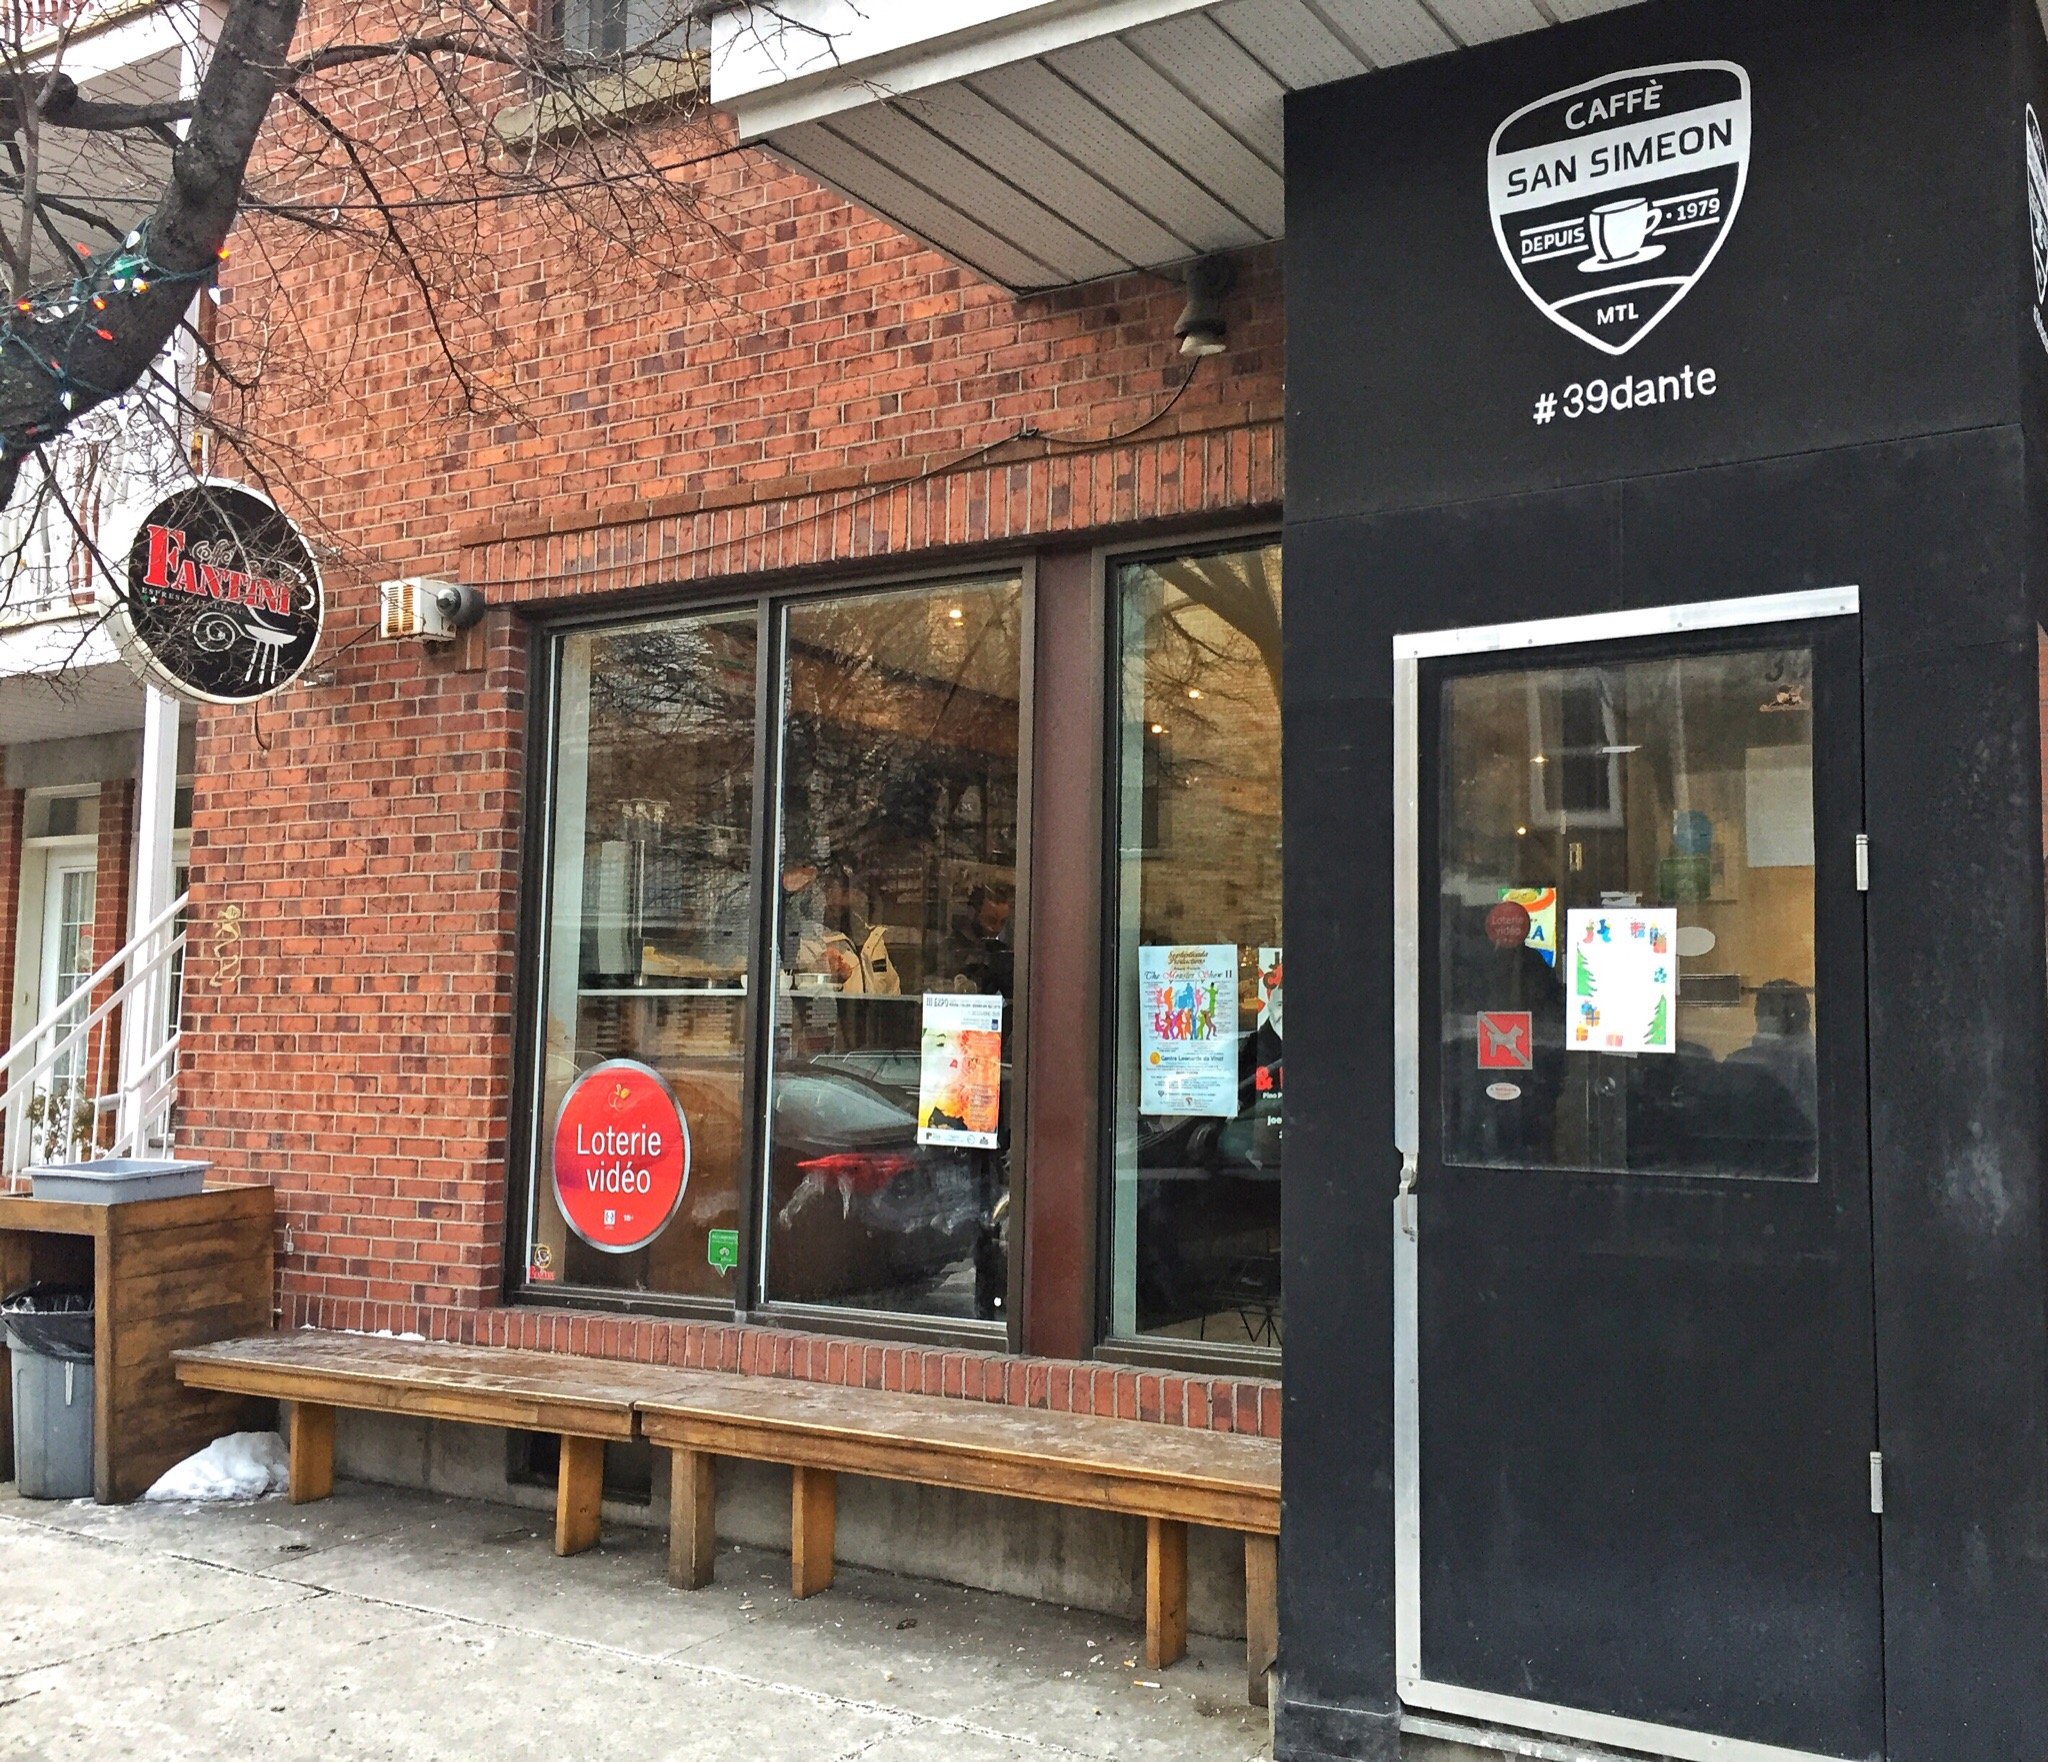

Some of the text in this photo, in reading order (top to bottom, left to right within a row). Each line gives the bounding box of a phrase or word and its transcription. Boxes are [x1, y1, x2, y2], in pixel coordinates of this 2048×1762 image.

[1565, 79, 1664, 131] CAFFÈ
[1506, 118, 1733, 198] SAN SIMEON
[1520, 198, 1721, 256] DEPUIS 1979
[1596, 302, 1640, 326] MTL
[1532, 363, 1718, 426] #39dante
[577, 1123, 662, 1158] Loterie
[586, 1160, 652, 1194] vidéo
